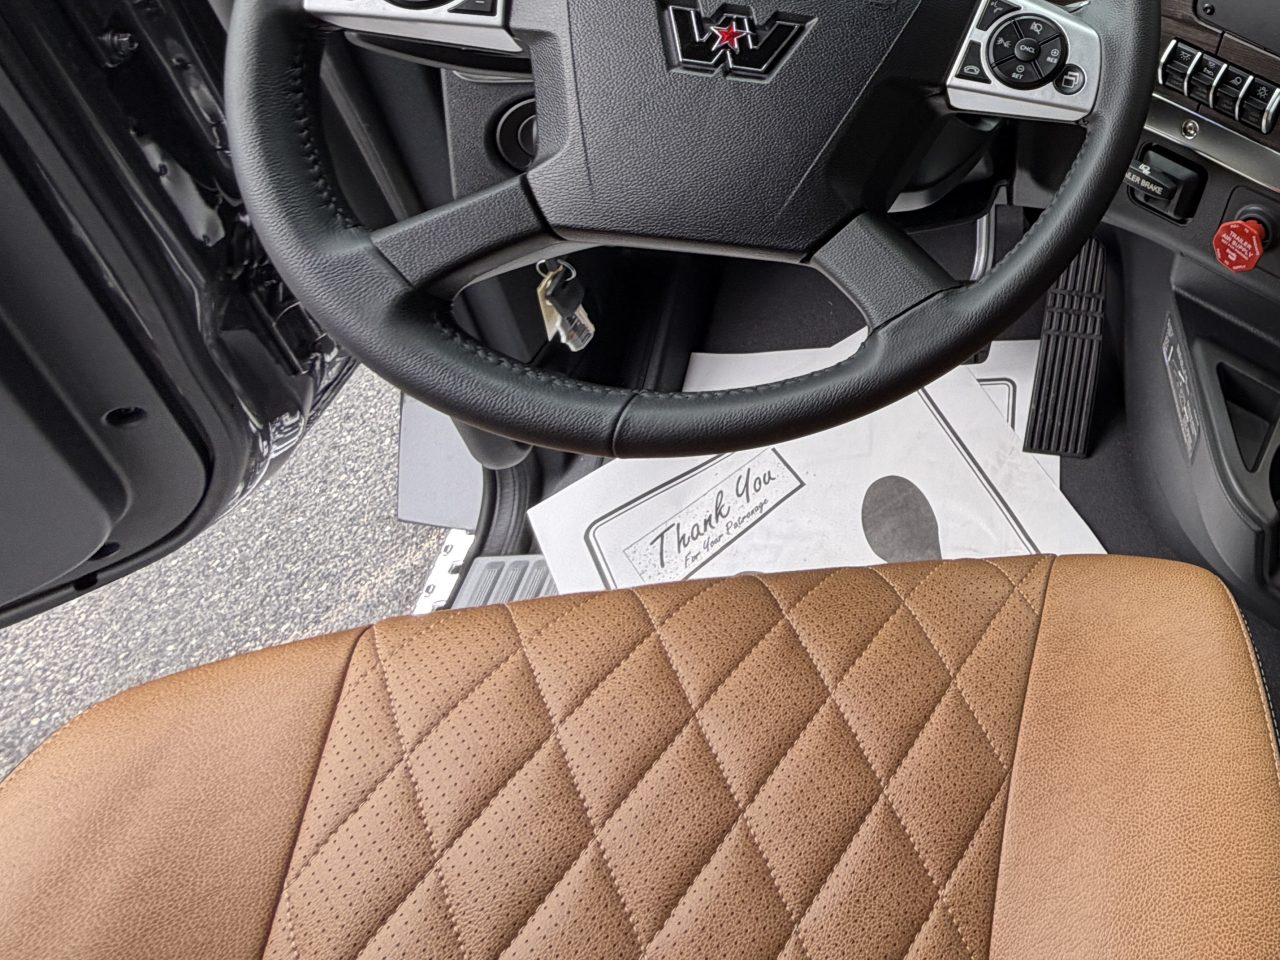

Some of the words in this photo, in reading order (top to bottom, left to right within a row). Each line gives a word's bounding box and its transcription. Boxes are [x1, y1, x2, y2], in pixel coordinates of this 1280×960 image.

[1124, 171, 1141, 184] ILER
[1140, 178, 1164, 195] BRAKE
[1230, 231, 1252, 249] TRAILER
[1231, 240, 1253, 257] SUPPLY
[650, 490, 730, 568] Thank
[735, 467, 776, 503] You
[684, 551, 700, 568] For
[702, 534, 723, 551] Your
[725, 498, 769, 535] Patronage
